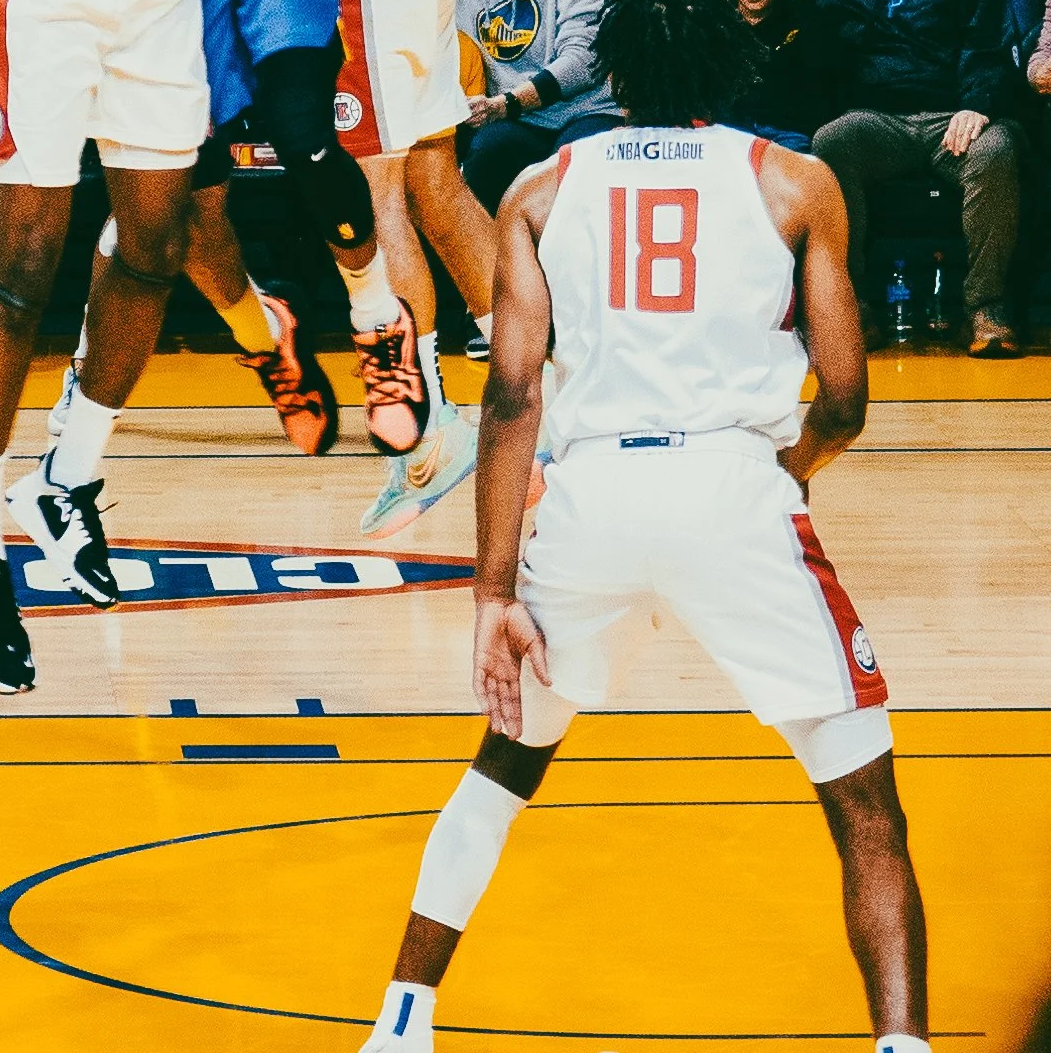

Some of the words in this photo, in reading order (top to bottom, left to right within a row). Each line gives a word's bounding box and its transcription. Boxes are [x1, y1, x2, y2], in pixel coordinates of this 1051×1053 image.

[617, 142, 641, 160] NBA
[642, 141, 660, 160] G
[662, 142, 705, 160] LEAGUE
[609, 186, 699, 314] 18
